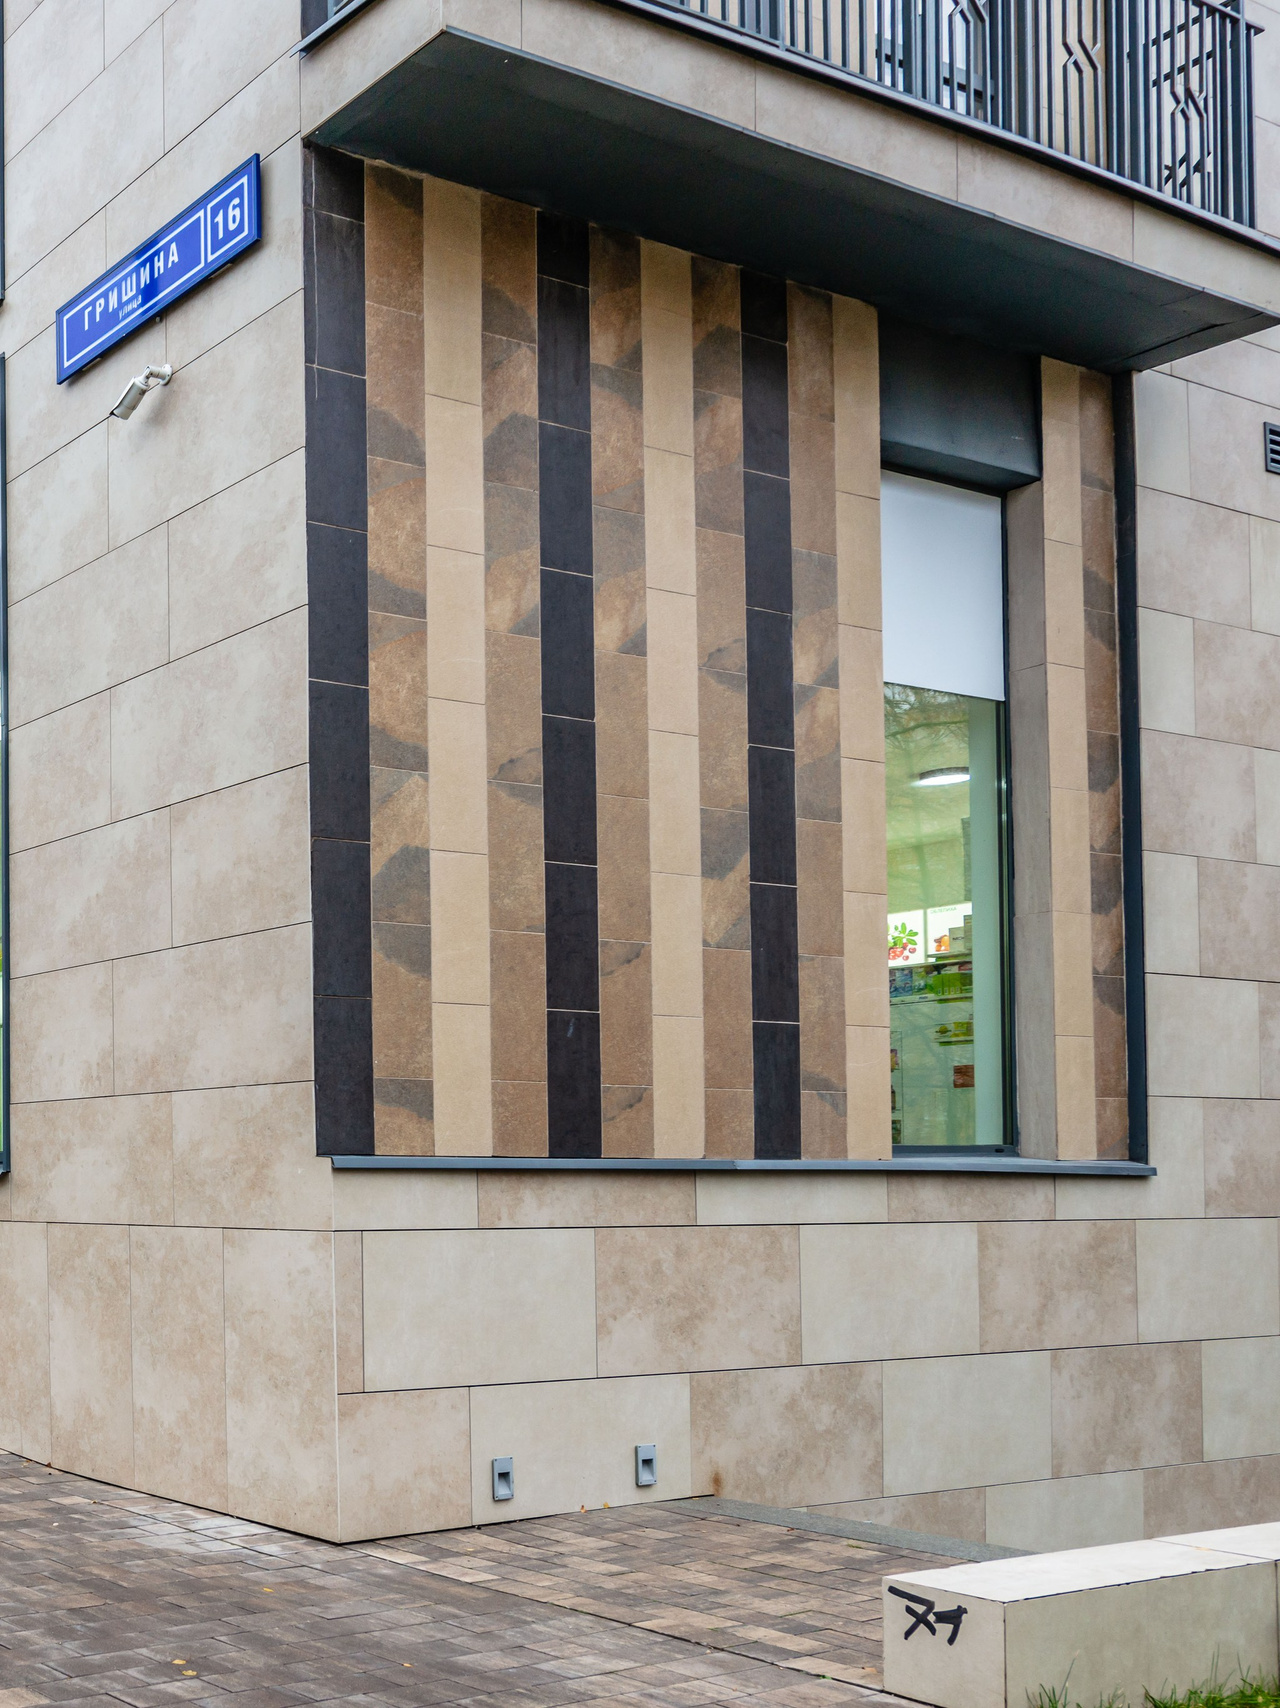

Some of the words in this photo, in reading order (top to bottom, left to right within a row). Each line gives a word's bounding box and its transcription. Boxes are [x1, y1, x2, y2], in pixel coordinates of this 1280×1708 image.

[213, 196, 241, 240] 16
[83, 241, 179, 331] ГРИШИНА
[118, 295, 142, 321] улица
